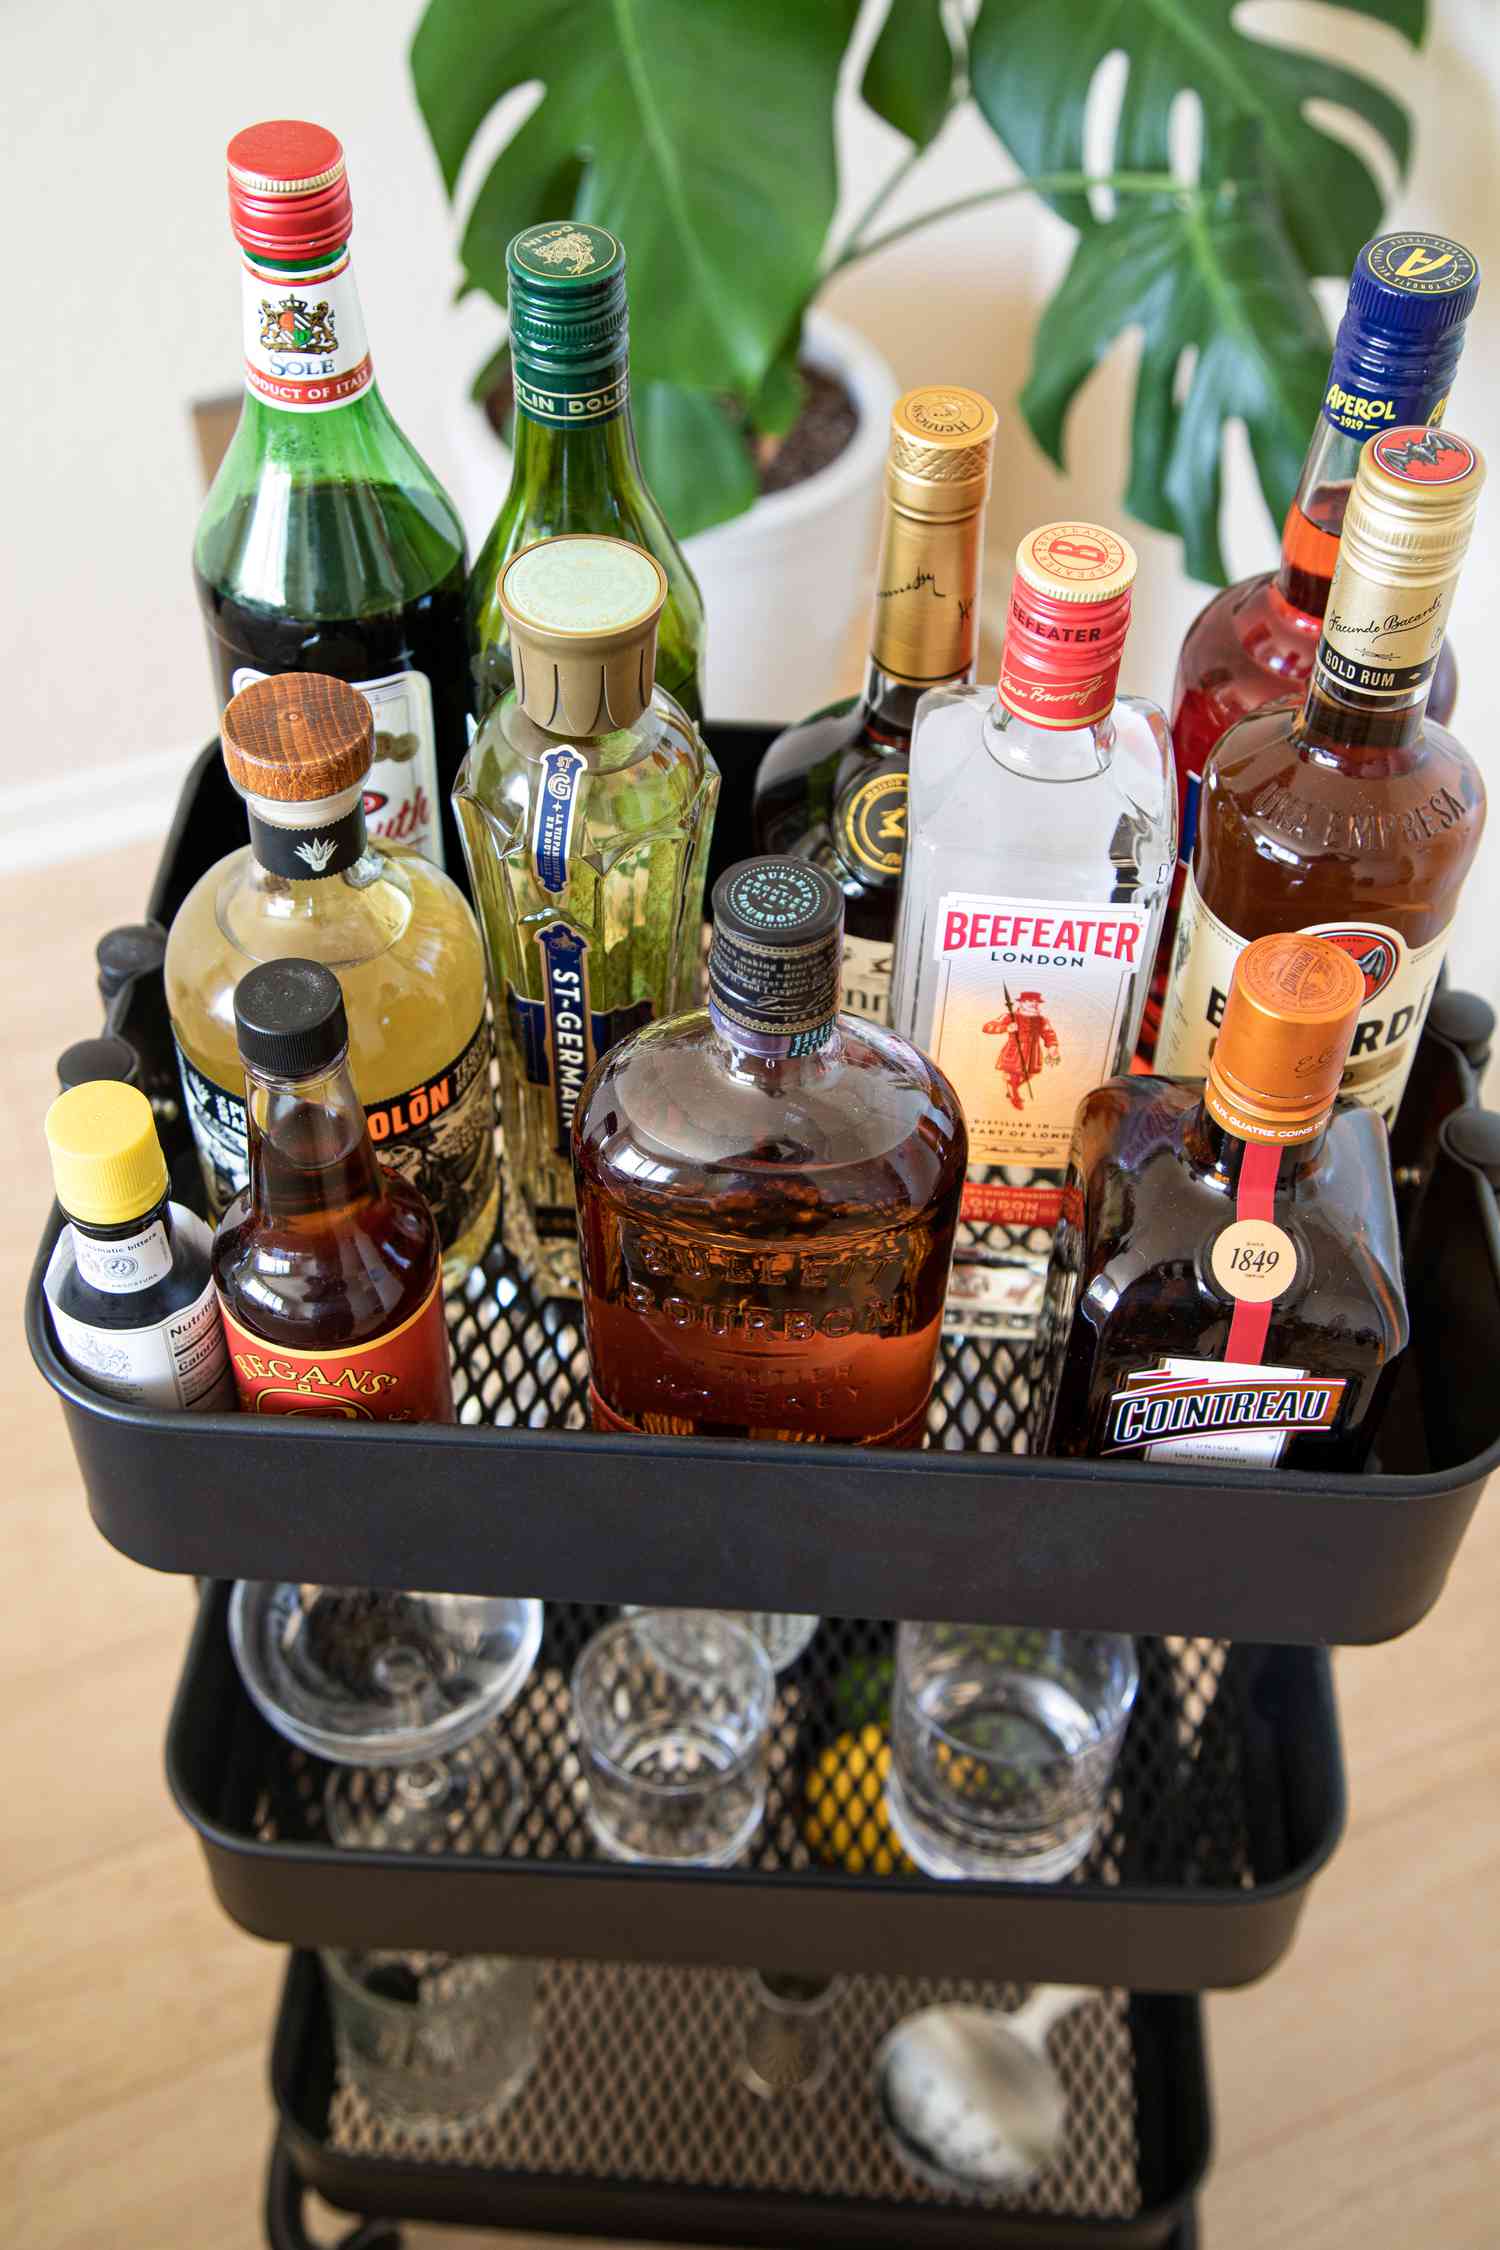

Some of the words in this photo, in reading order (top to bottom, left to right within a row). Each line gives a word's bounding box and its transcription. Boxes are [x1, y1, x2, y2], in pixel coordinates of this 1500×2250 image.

[1395, 248, 1454, 277] A
[270, 356, 335, 376] SOLE
[307, 388, 330, 399] OF
[336, 366, 368, 394] ITALY
[1327, 383, 1396, 420] APEROL
[1340, 414, 1364, 431] 1919
[1049, 539, 1106, 564] B
[1329, 610, 1381, 635] Facundo
[1324, 649, 1356, 680] GOLD
[1360, 668, 1396, 688] RUM
[943, 911, 1141, 963] BEEFEATER
[992, 951, 1085, 968] LONDON
[1229, 1115, 1276, 1137] QUATRE
[1278, 1127, 1313, 1138] COINS
[127, 1232, 157, 1251] bitters
[1230, 1247, 1280, 1273] 1849
[170, 1296, 218, 1338] Nutritio
[1114, 1391, 1332, 1443] COINTREAU
